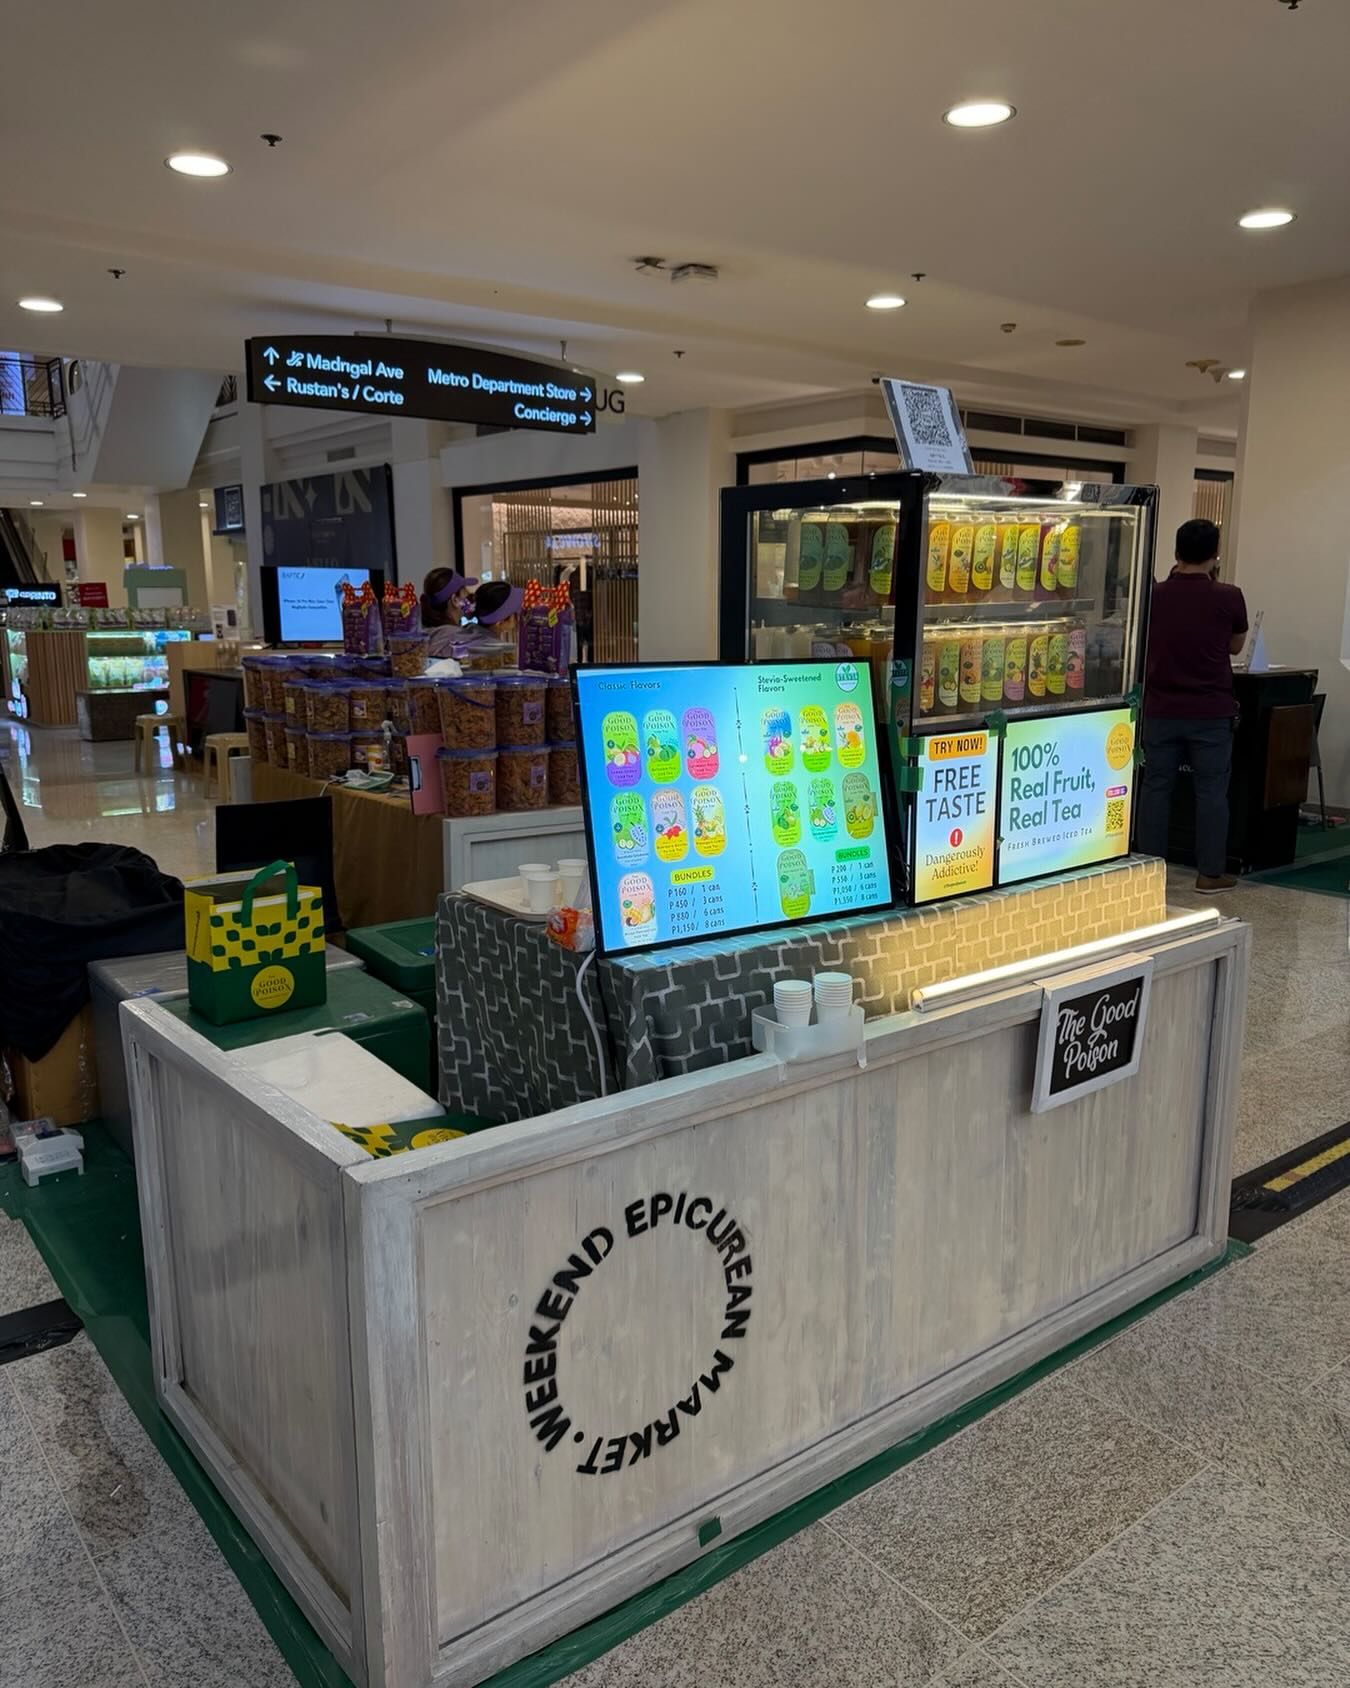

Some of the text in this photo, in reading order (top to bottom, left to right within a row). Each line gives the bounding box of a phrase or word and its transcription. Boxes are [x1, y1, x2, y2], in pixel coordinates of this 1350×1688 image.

[306, 352, 404, 380] Madrigal Ave
[286, 376, 404, 406] Rustan's / Corte
[427, 367, 577, 401] Metro Department Store
[514, 402, 577, 426] Concierge
[598, 680, 661, 691] Classic Flavors
[757, 674, 822, 685] Stevia-Sweetened
[758, 685, 786, 693] Flavors
[934, 737, 984, 755] TRY NOW!
[1011, 741, 1061, 773] 100%
[933, 764, 981, 793] FREE
[1010, 772, 1049, 802] Real
[1052, 766, 1096, 795] Fruit,
[925, 791, 986, 823] TASTE
[1009, 799, 1082, 832] Real Tea
[1008, 841, 1030, 851] FRESH
[1032, 833, 1061, 847] BREWED
[925, 845, 986, 867] Dangerously
[674, 869, 712, 882] BUNDLES
[931, 859, 979, 881] Addictive!
[708, 884, 721, 892] can
[708, 896, 724, 904] cans
[709, 908, 725, 916] cans
[710, 919, 726, 928] cans
[253, 983, 292, 997] POISON
[259, 978, 287, 988] GOOD
[1056, 987, 1141, 1046] The Good
[1063, 1040, 1119, 1080] Poison
[523, 1226, 615, 1453] WEEKEND
[624, 1192, 753, 1340] EPICUREAN
